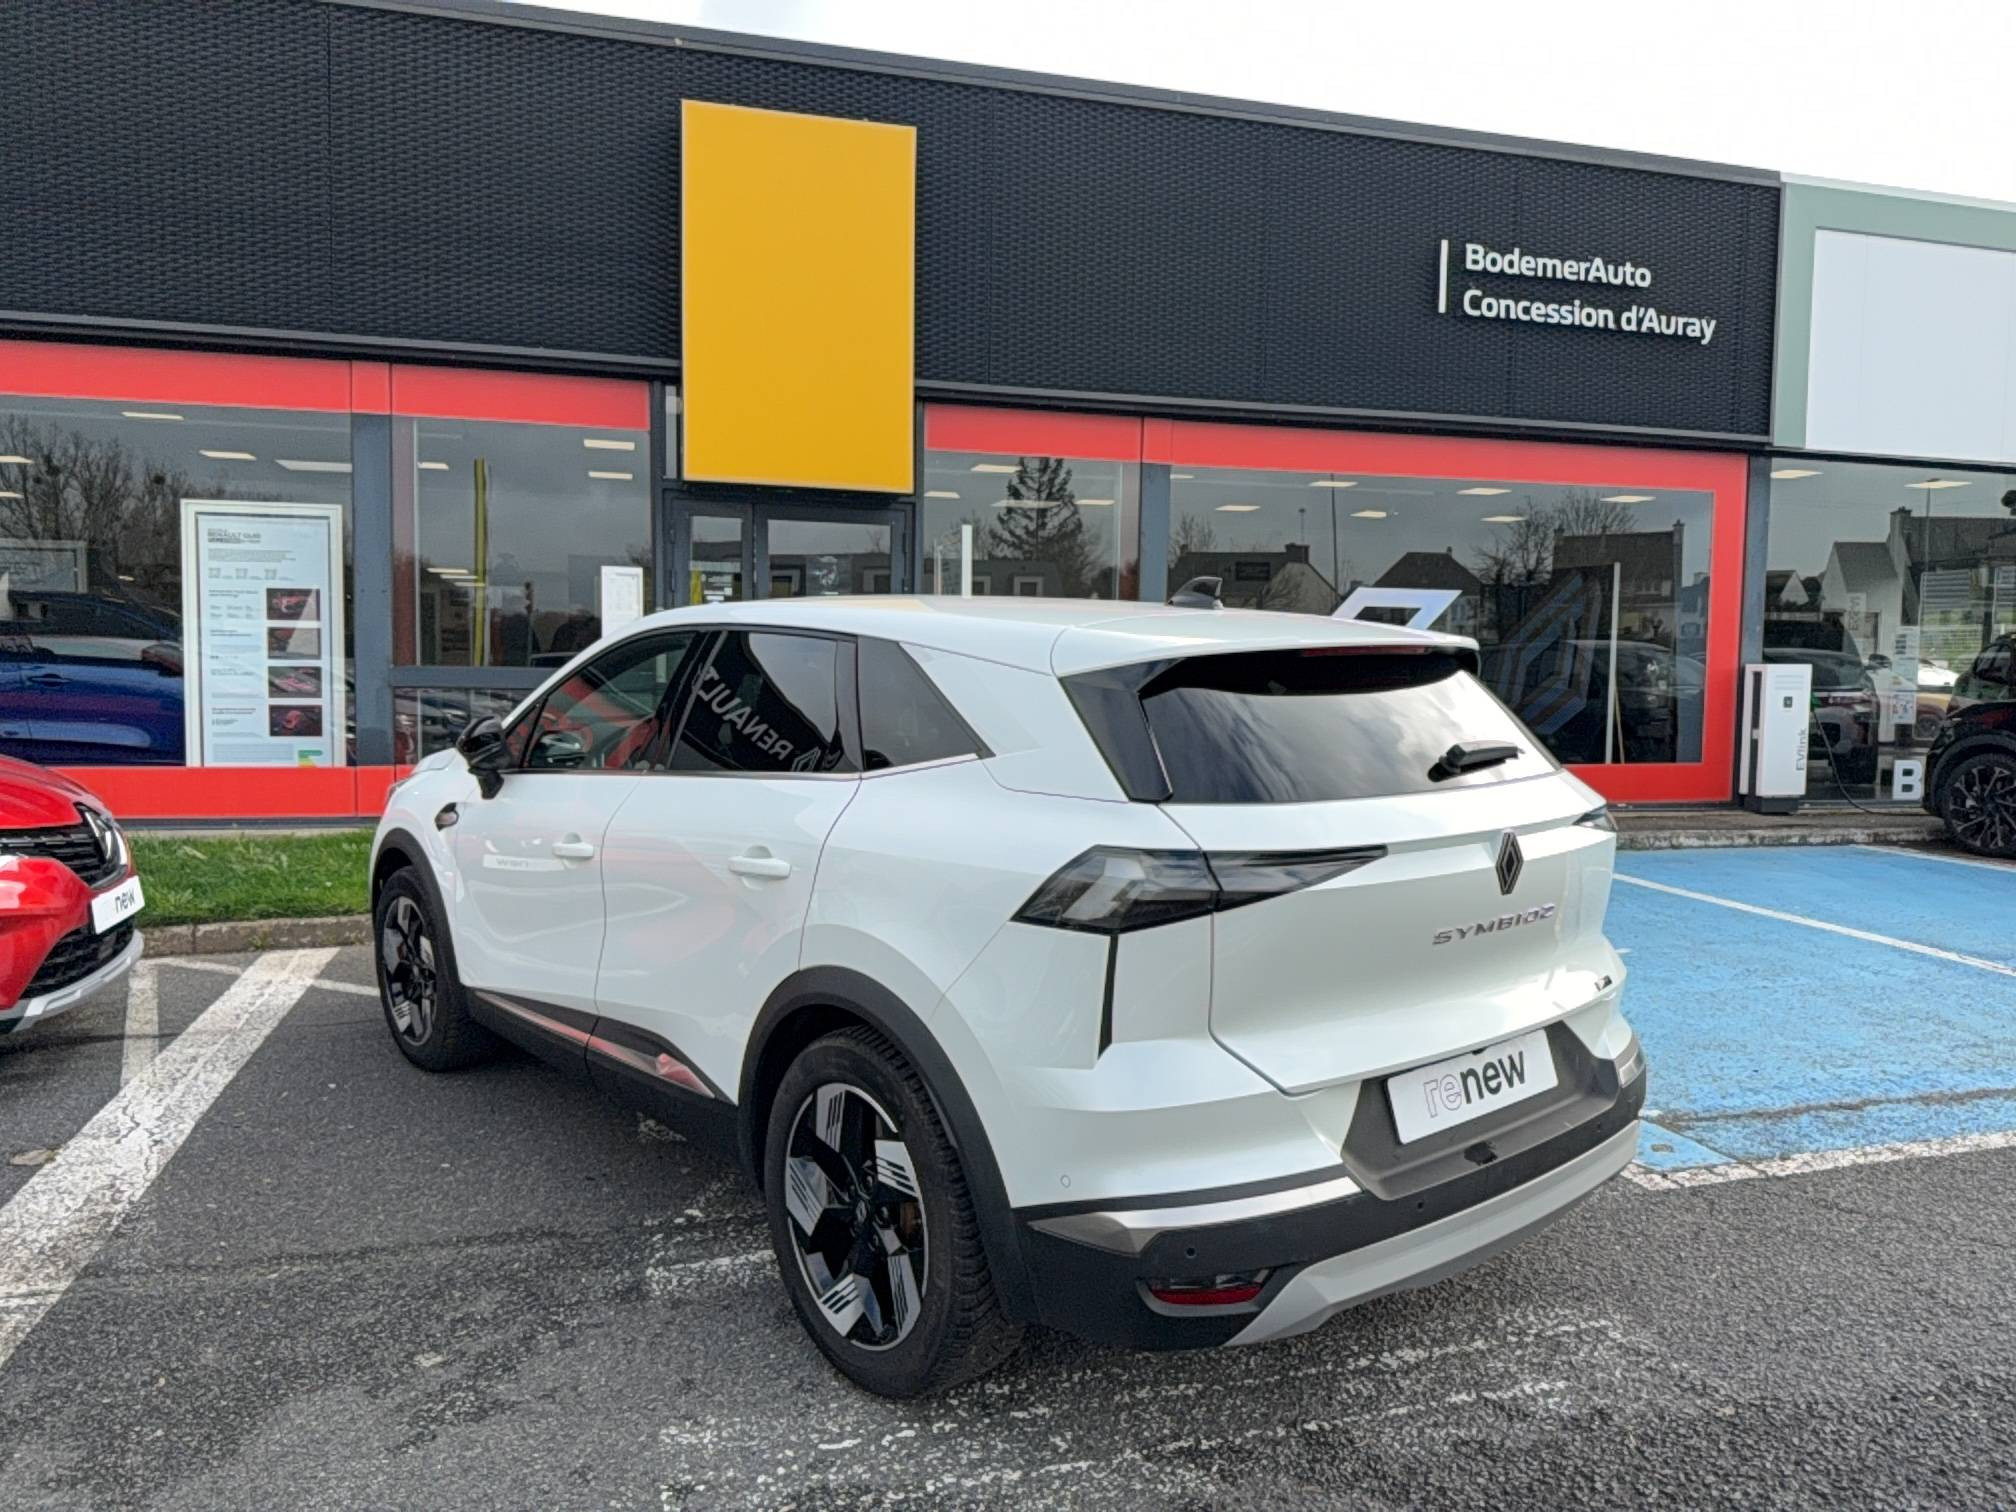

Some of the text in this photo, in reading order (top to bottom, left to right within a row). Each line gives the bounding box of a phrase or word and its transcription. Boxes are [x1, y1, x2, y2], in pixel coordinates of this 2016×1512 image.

[1465, 243, 1651, 288] BodemerAuto
[1463, 289, 1717, 345] Concession d'Auray
[1432, 903, 1555, 946] SYMBIOZ
[1423, 1050, 1526, 1118] renew
